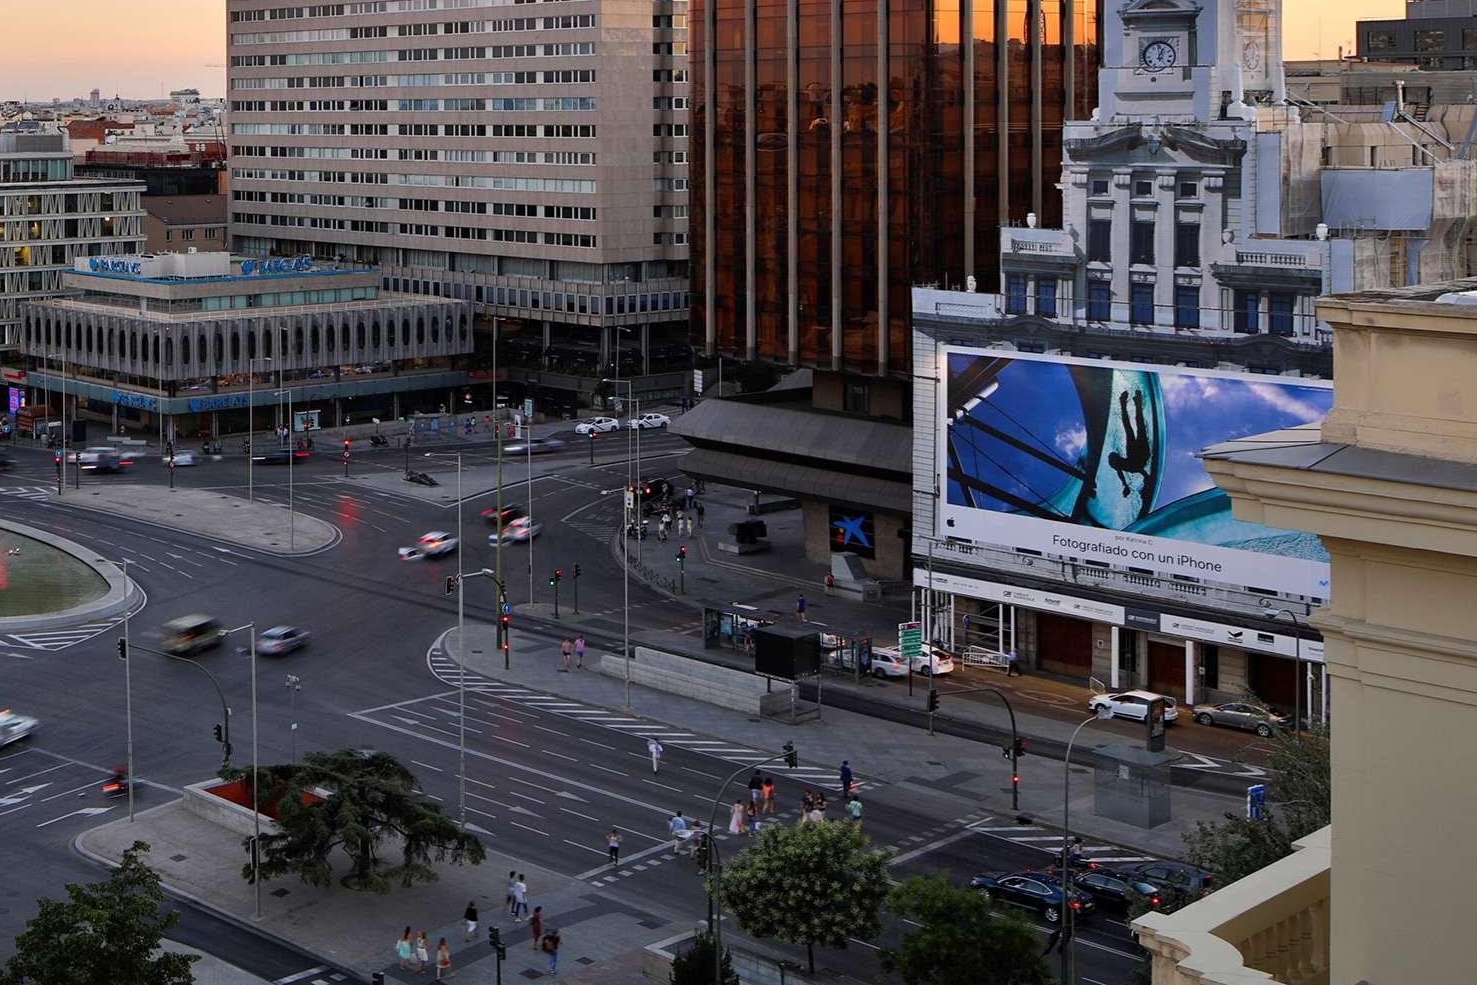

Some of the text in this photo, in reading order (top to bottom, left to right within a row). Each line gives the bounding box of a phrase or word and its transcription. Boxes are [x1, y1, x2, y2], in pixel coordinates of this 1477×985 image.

[1052, 534, 1222, 573] Fotografiado con un iPhone
